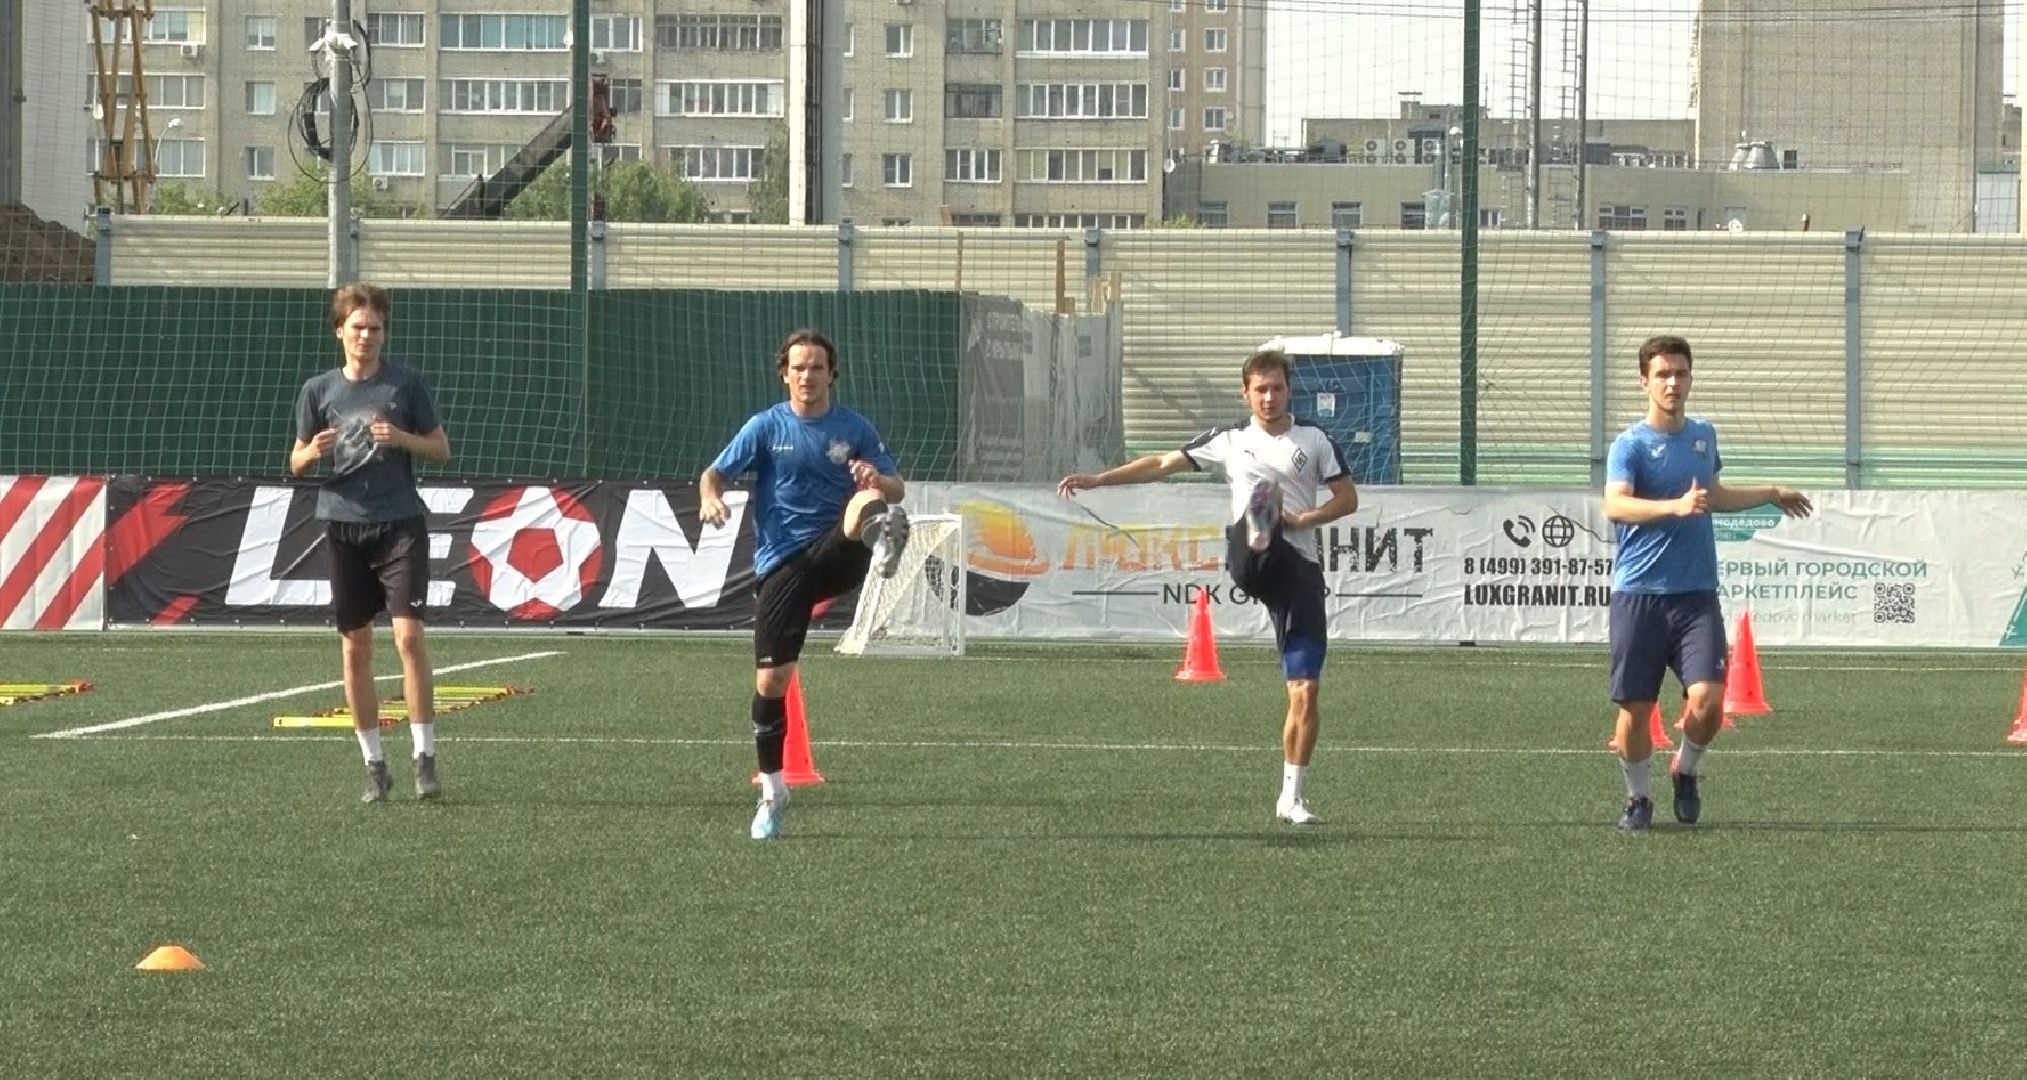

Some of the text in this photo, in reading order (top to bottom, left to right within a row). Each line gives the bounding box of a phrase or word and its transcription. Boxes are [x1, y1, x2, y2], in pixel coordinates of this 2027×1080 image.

[1464, 557, 1474, 574] 8
[1531, 557, 1613, 575] 391-87-57
[1717, 558, 1928, 579] ЕРВЫЙ ГОРОДСКОЙ
[1464, 585, 1611, 607] LUXGRANIT.RU
[1718, 583, 1858, 600] АРКЕТПЛЕЙС
